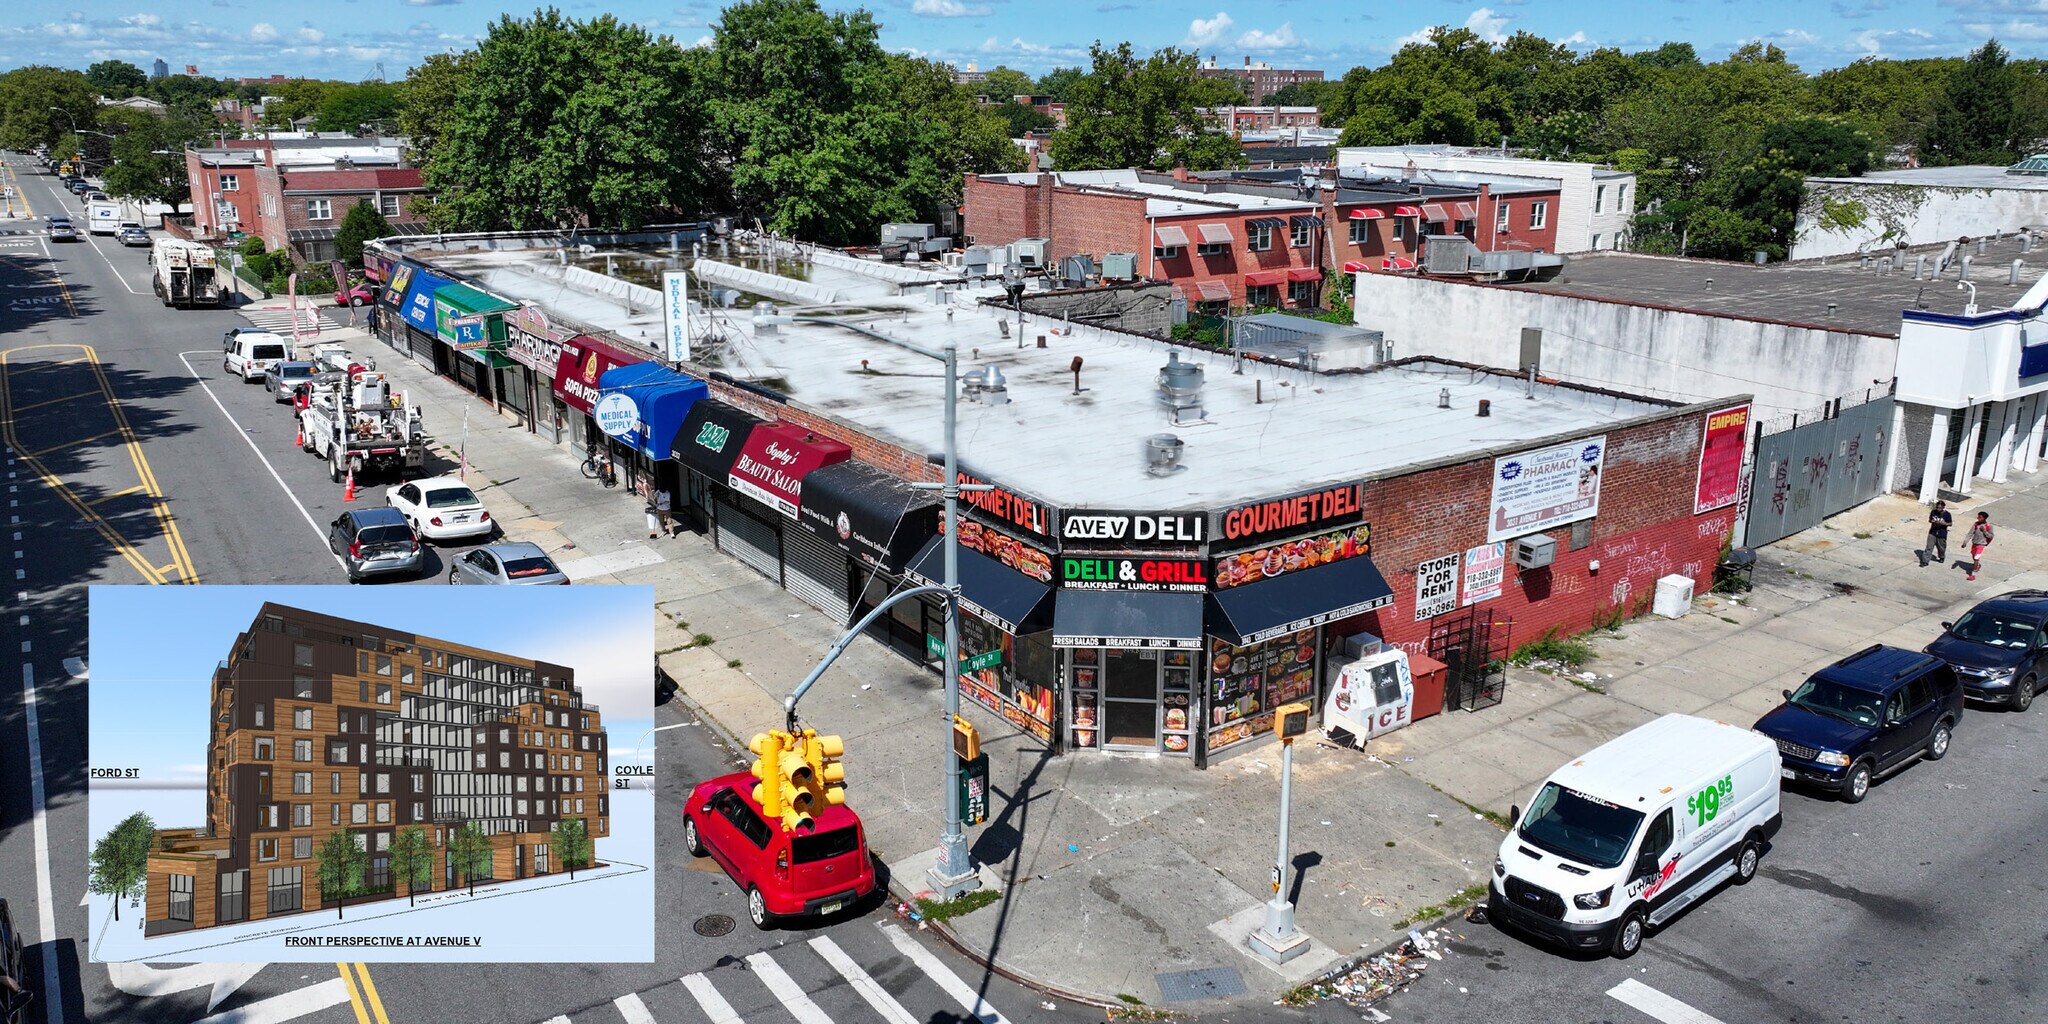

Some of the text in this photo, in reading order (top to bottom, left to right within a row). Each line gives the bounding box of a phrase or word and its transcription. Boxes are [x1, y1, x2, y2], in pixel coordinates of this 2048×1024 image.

[670, 278, 681, 320] MEDICAL
[673, 324, 683, 360] SUPPLY
[564, 377, 583, 398] SOFIA
[601, 410, 633, 420] MEDICAL
[604, 420, 631, 431] SUPPLY
[1709, 411, 1747, 431] EMPIRE
[696, 421, 730, 453] ZAZA
[765, 441, 800, 465] Sophy's
[737, 453, 802, 497] BEAUTY SALON
[1524, 457, 1579, 479] PHARMACY
[1014, 495, 1047, 536] DELI
[1226, 485, 1361, 539] GOURMET DELI
[1519, 513, 1538, 525] AVENUE
[1538, 511, 1543, 519] V
[1134, 516, 1202, 541] DELI
[1064, 559, 1207, 583] DELI & GRILL
[1420, 554, 1458, 575] STORE
[1064, 581, 1207, 592] BREAKFAST LUNCH DINNER
[1426, 569, 1451, 586] FOR
[1421, 580, 1453, 599] RENT
[1416, 599, 1455, 619] 593-0962
[931, 639, 940, 653] Ave
[1053, 638, 1201, 648] FRESH SALADS BREAKFAST LUNCH DINNER
[967, 653, 993, 670] Coyle St
[1141, 650, 1155, 659] EBT
[1367, 703, 1406, 732] ICE
[1576, 790, 1606, 806] U-HAUL
[1627, 871, 1663, 899] U-HAUL
